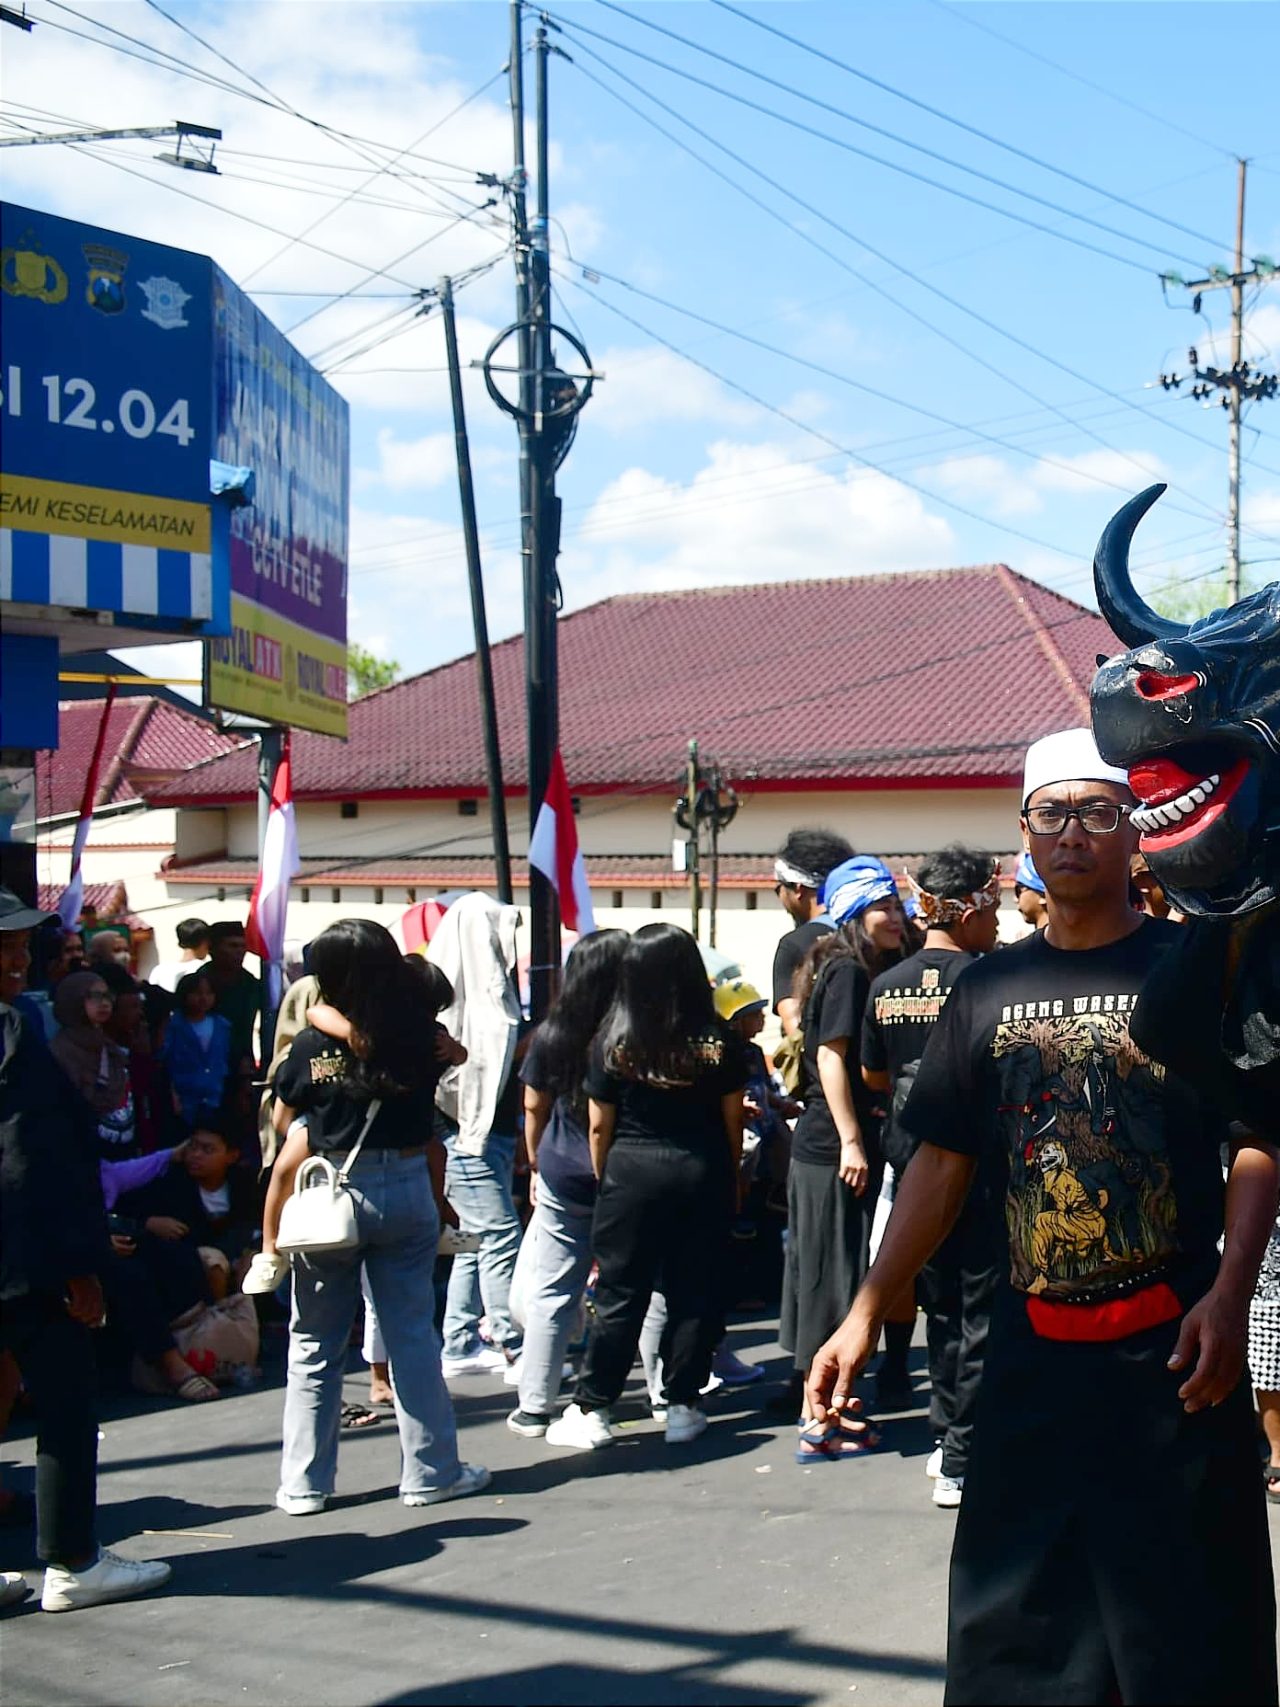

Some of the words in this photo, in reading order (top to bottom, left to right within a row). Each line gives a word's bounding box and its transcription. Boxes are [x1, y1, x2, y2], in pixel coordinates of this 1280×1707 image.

[42, 375, 195, 446] 12.04
[45, 500, 195, 536] KESELAMATAN
[253, 527, 290, 588] CCTV
[292, 552, 323, 607] ETLE
[1002, 999, 1064, 1023] AGENG
